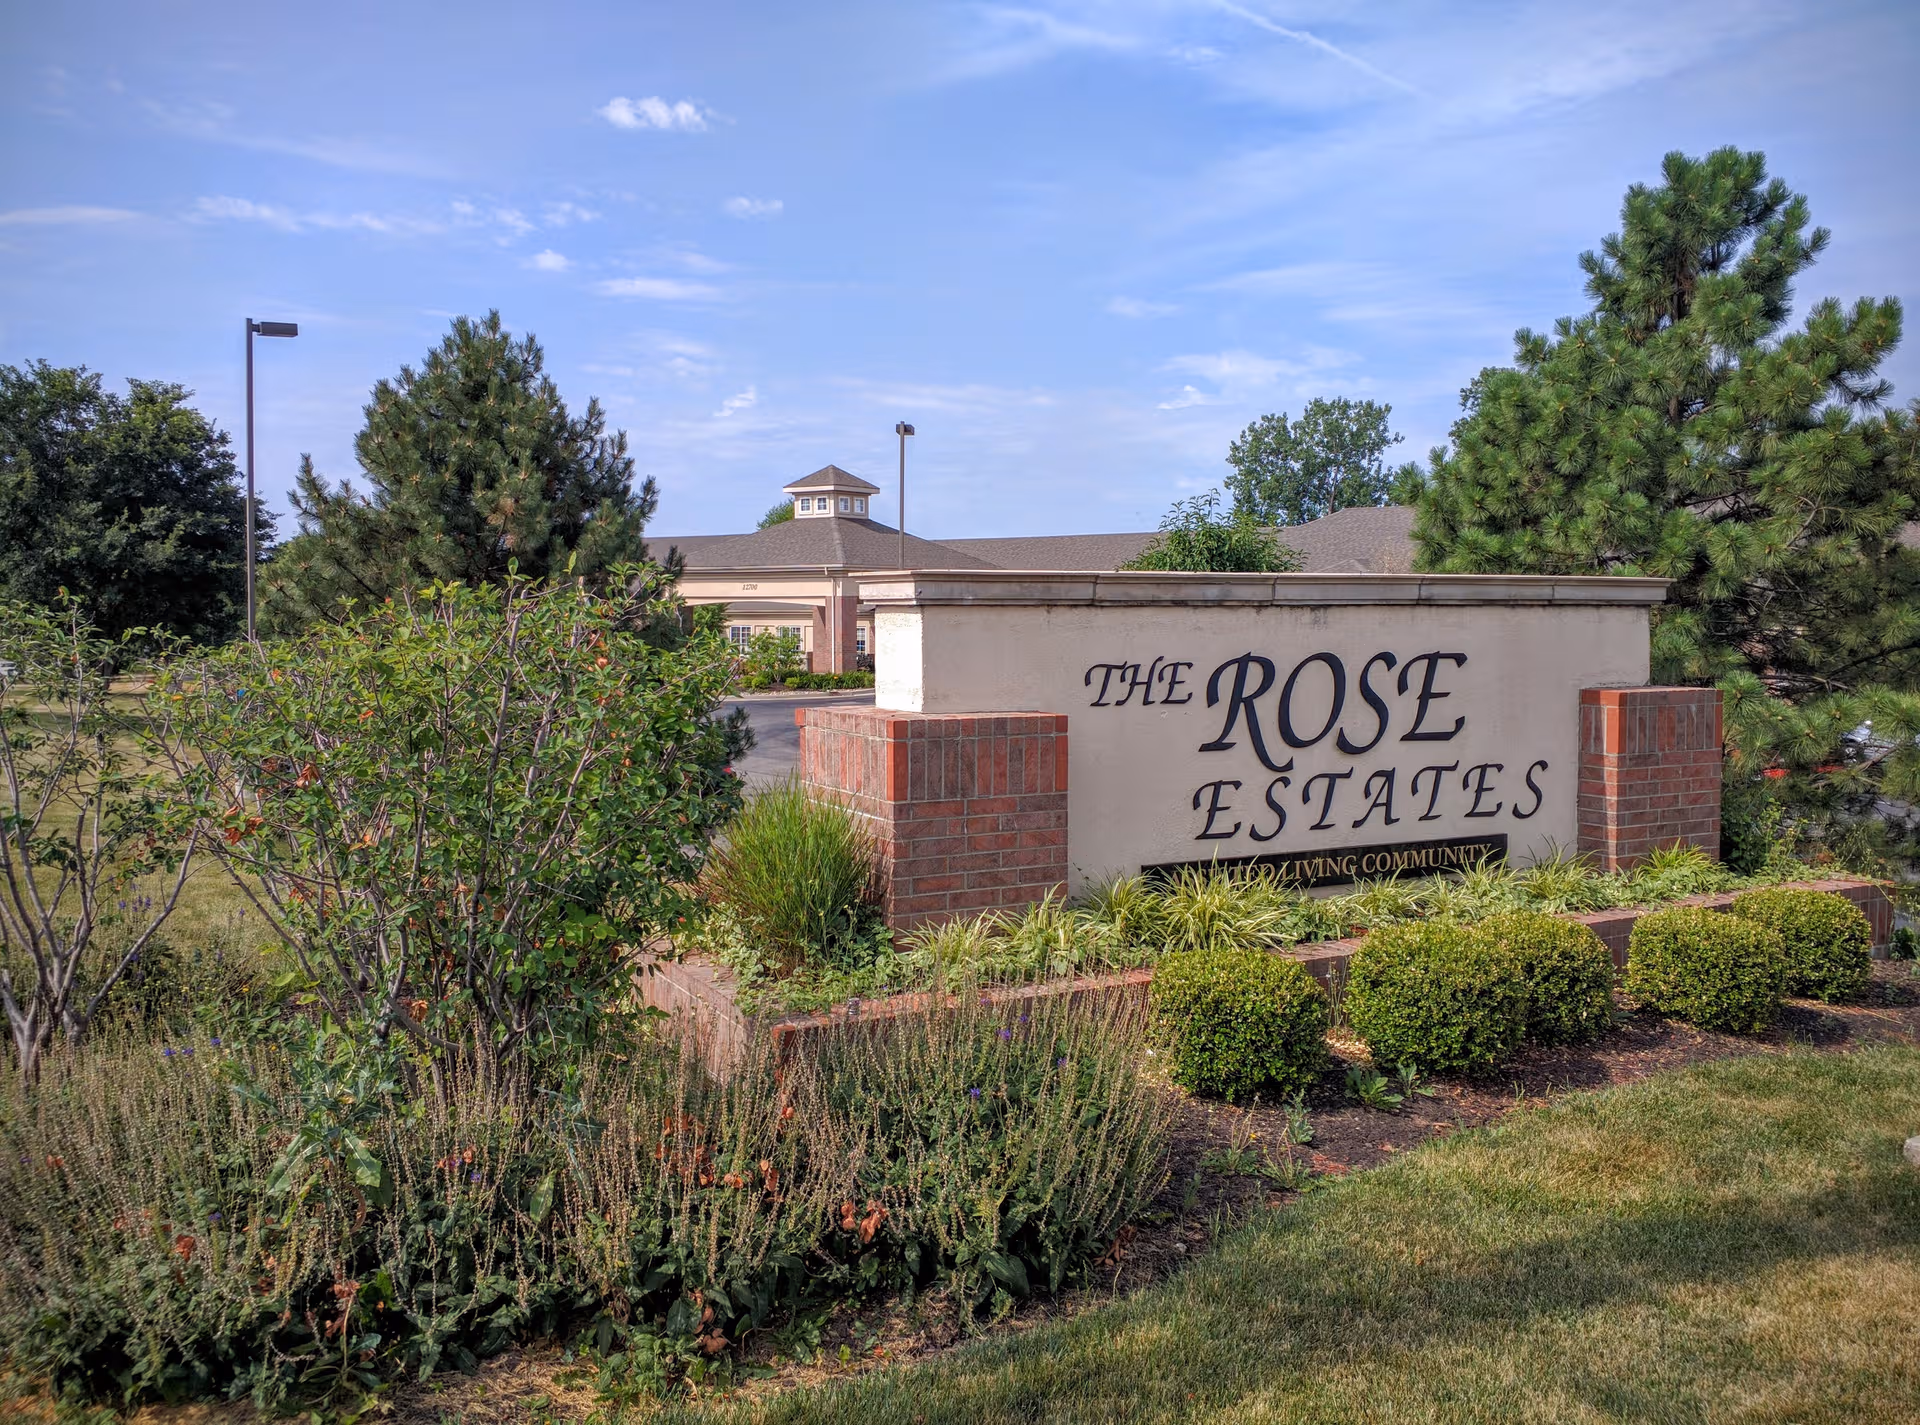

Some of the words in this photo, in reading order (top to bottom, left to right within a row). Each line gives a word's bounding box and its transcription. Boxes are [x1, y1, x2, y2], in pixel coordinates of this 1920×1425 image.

[1085, 655, 1194, 707] THE
[1198, 651, 1468, 774] ROSE
[1193, 759, 1549, 842] ESTATES
[1281, 855, 1358, 883] LIVING
[1361, 843, 1492, 874] COMMUNITY
